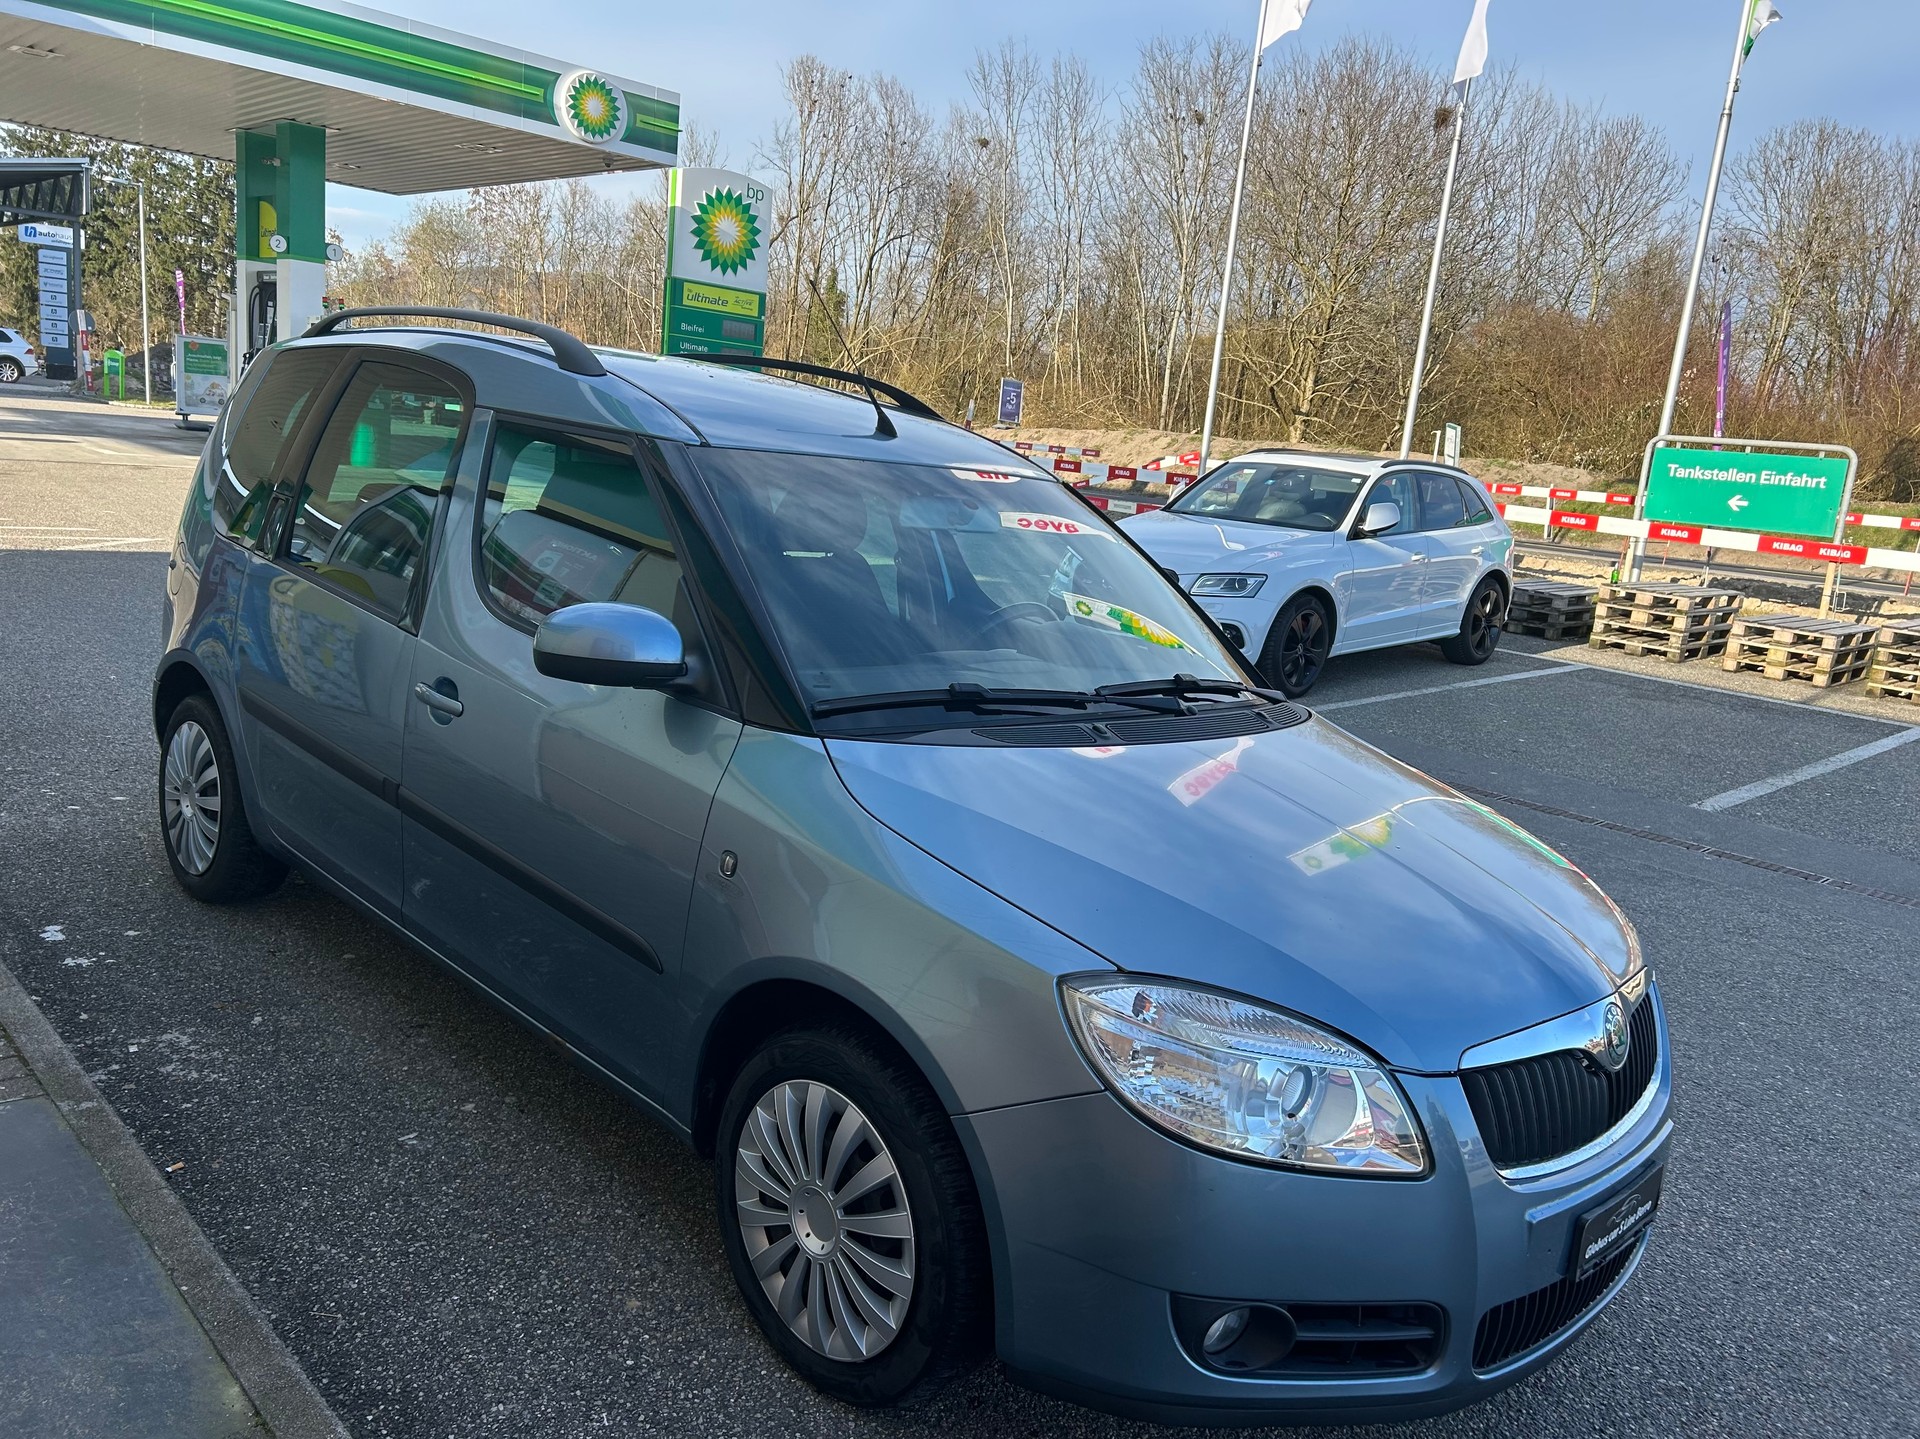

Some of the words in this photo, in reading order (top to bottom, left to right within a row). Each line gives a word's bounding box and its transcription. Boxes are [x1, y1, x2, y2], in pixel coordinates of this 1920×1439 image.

[746, 183, 764, 204] bp
[38, 230, 72, 241] autohaus
[275, 238, 281, 249] 2
[332, 248, 337, 258] 1
[686, 291, 729, 308] ultimate
[680, 322, 705, 334] Bleifrei
[679, 341, 709, 353] Ultimate
[1060, 462, 1076, 470] KIBAG
[1114, 469, 1130, 477] KIBAG
[1667, 463, 1756, 484] Tankstellen
[1759, 470, 1827, 489] Einfahrt
[1613, 495, 1630, 503] KIBAG
[1561, 515, 1586, 526] KIBAG
[1660, 528, 1689, 539] KIBAG
[1772, 541, 1803, 552] KIBAG
[1819, 547, 1851, 559] KIBAG
